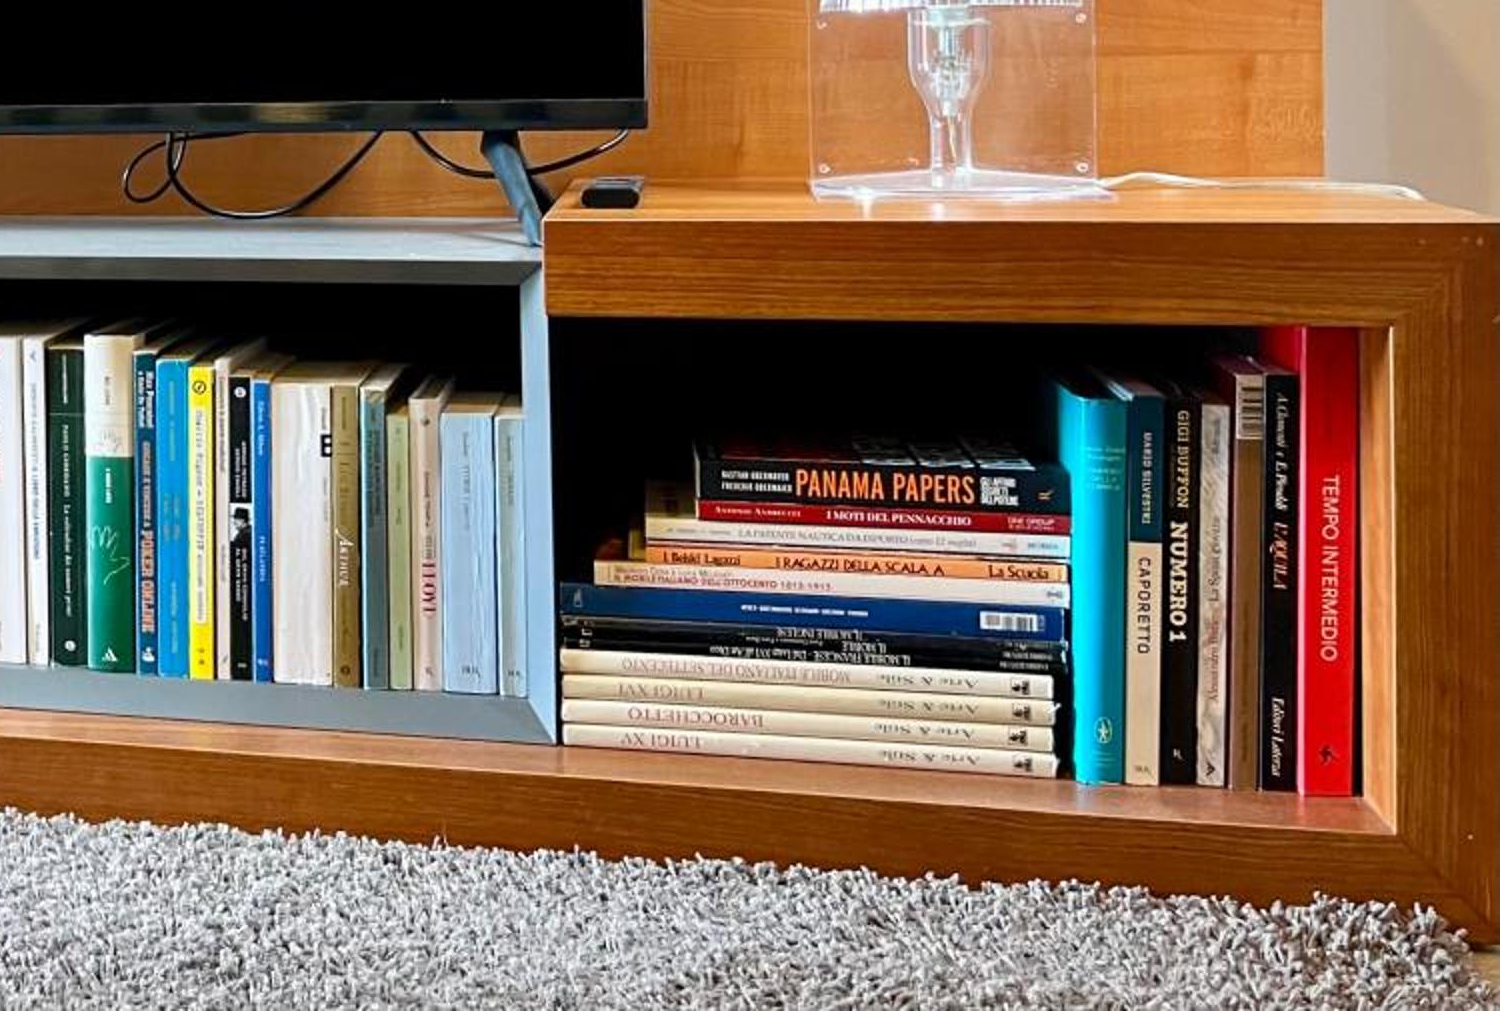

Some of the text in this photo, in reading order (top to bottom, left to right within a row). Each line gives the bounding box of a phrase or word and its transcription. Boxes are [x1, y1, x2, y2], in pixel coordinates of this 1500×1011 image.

[1175, 410, 1191, 509] GIGI BUFFON
[795, 468, 977, 504] PANAMA PAPERS
[1141, 431, 1153, 525] MARIO SILVESTRI
[833, 511, 864, 522] MOTI
[866, 512, 888, 523] DEL
[890, 513, 972, 527] PENNACCHIO
[798, 530, 845, 544] NAUTICA
[1269, 520, 1288, 589] L'AQUILA
[784, 557, 839, 570] RAGAZZI
[843, 559, 881, 572] DELLA
[885, 561, 928, 574] SCALA
[932, 564, 946, 576] A
[987, 564, 1050, 580] La Scuola
[1319, 474, 1341, 662] TEMPO INTERMEDIO
[140, 529, 156, 633] POKER ONLINE
[1168, 521, 1189, 642] NUMERO 1
[1208, 589, 1219, 602] La
[1136, 556, 1152, 655] CAPORETTO
[775, 629, 815, 640] INGLESE
[842, 642, 877, 653] MOBILE
[813, 651, 862, 665] FRANCESE
[622, 658, 850, 684] MOBILE ITALIANO DEL SETTECENTO
[878, 673, 913, 687] Stile
[616, 683, 704, 700] LUIGI XVI
[941, 677, 979, 690] Arte
[878, 699, 979, 715] Arte & Stile
[627, 707, 765, 728] BAROCCHETTO
[619, 731, 700, 750] LUIGI XV
[873, 724, 976, 739] Arte & Stile
[1270, 696, 1286, 777] Editori Laterza
[879, 749, 980, 765] Arte & Stile
